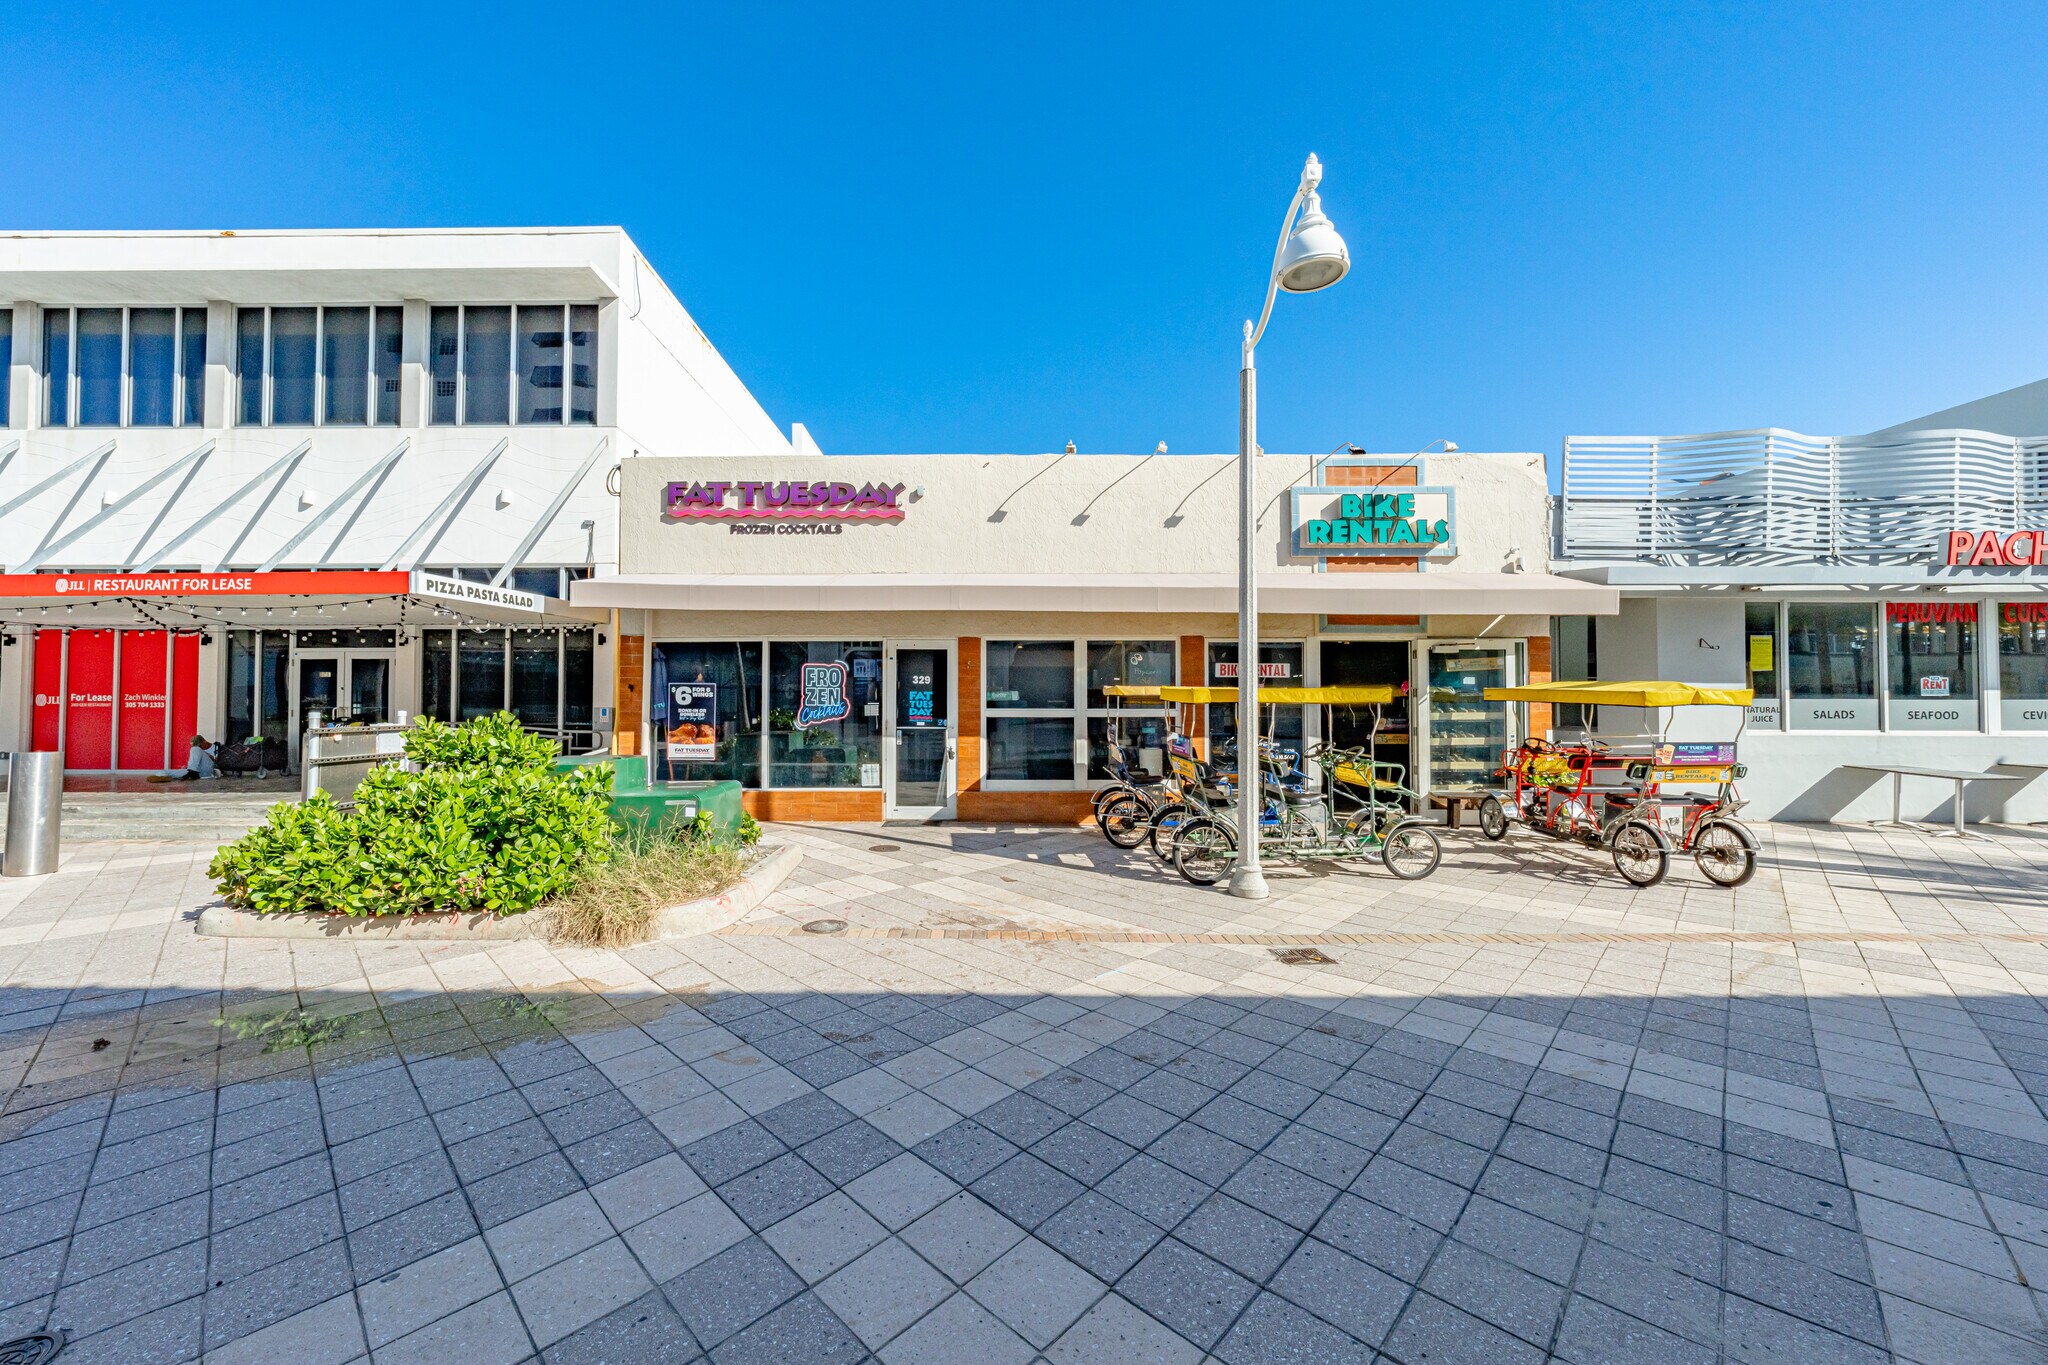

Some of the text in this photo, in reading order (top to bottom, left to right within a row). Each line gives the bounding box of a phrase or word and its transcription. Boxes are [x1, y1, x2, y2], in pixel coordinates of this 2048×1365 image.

[667, 480, 907, 507] FAT TUESDAY
[1341, 493, 1416, 518] BIKE
[730, 525, 842, 535] FROZEN COCKTAILS
[1308, 519, 1450, 544] RENTALS
[68, 578, 252, 591] JLL RESTAURANT FOR LEASE
[426, 579, 533, 607] PIZZA PASTA SALAD
[1886, 602, 1977, 623] PERUVIAN
[1219, 664, 1239, 676] BIK
[805, 668, 842, 687] FRO
[912, 675, 931, 684] 329
[70, 694, 112, 702] For Lease
[805, 687, 841, 706] ZEN
[909, 691, 933, 700] FAT
[909, 700, 933, 708] TUES
[801, 701, 846, 721] Cocktails
[1813, 710, 1855, 719] SALADS
[1907, 711, 1959, 720] SEAFOOD
